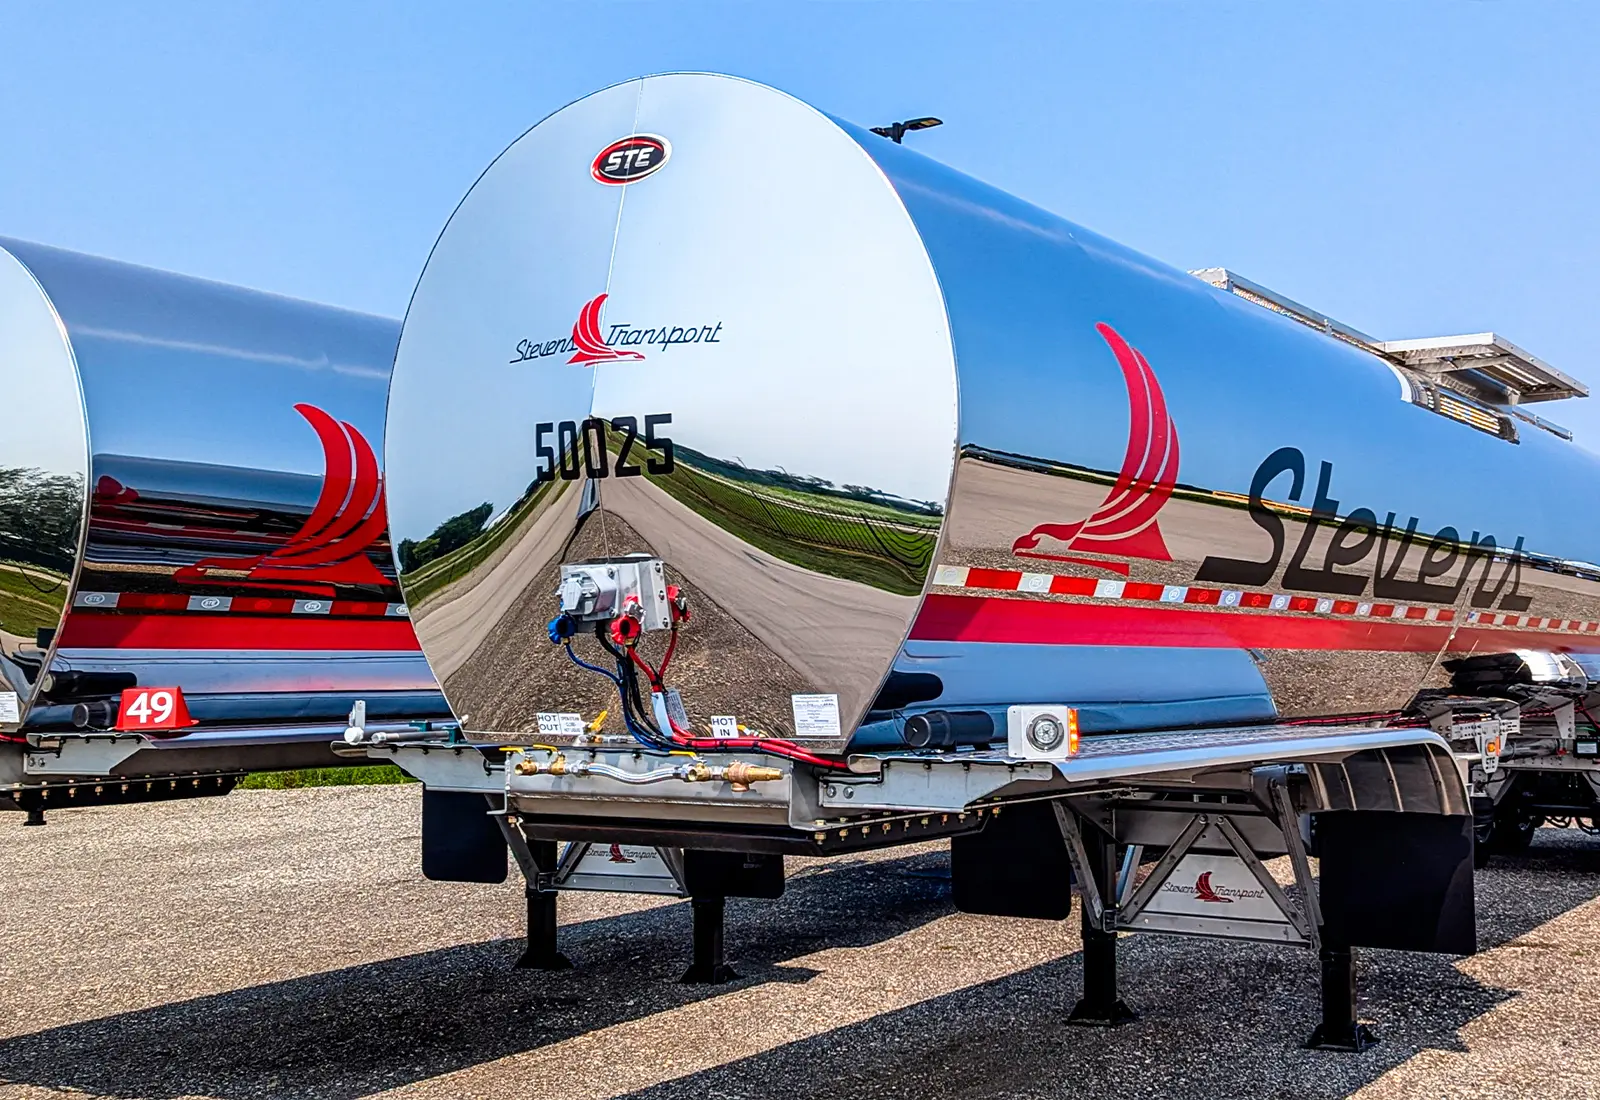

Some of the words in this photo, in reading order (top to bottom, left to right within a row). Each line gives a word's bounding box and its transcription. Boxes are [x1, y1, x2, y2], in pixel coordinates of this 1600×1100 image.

[604, 147, 655, 172] STE
[509, 338, 578, 364] Stevens
[605, 321, 723, 352] Transport
[535, 413, 675, 482] 50025
[1194, 447, 1533, 612] Stevens
[126, 691, 173, 724] 49
[537, 714, 557, 722] HOT
[540, 723, 559, 731] OUT
[712, 717, 734, 726] HOT
[719, 728, 731, 737] IN
[1214, 885, 1265, 900] Transport
